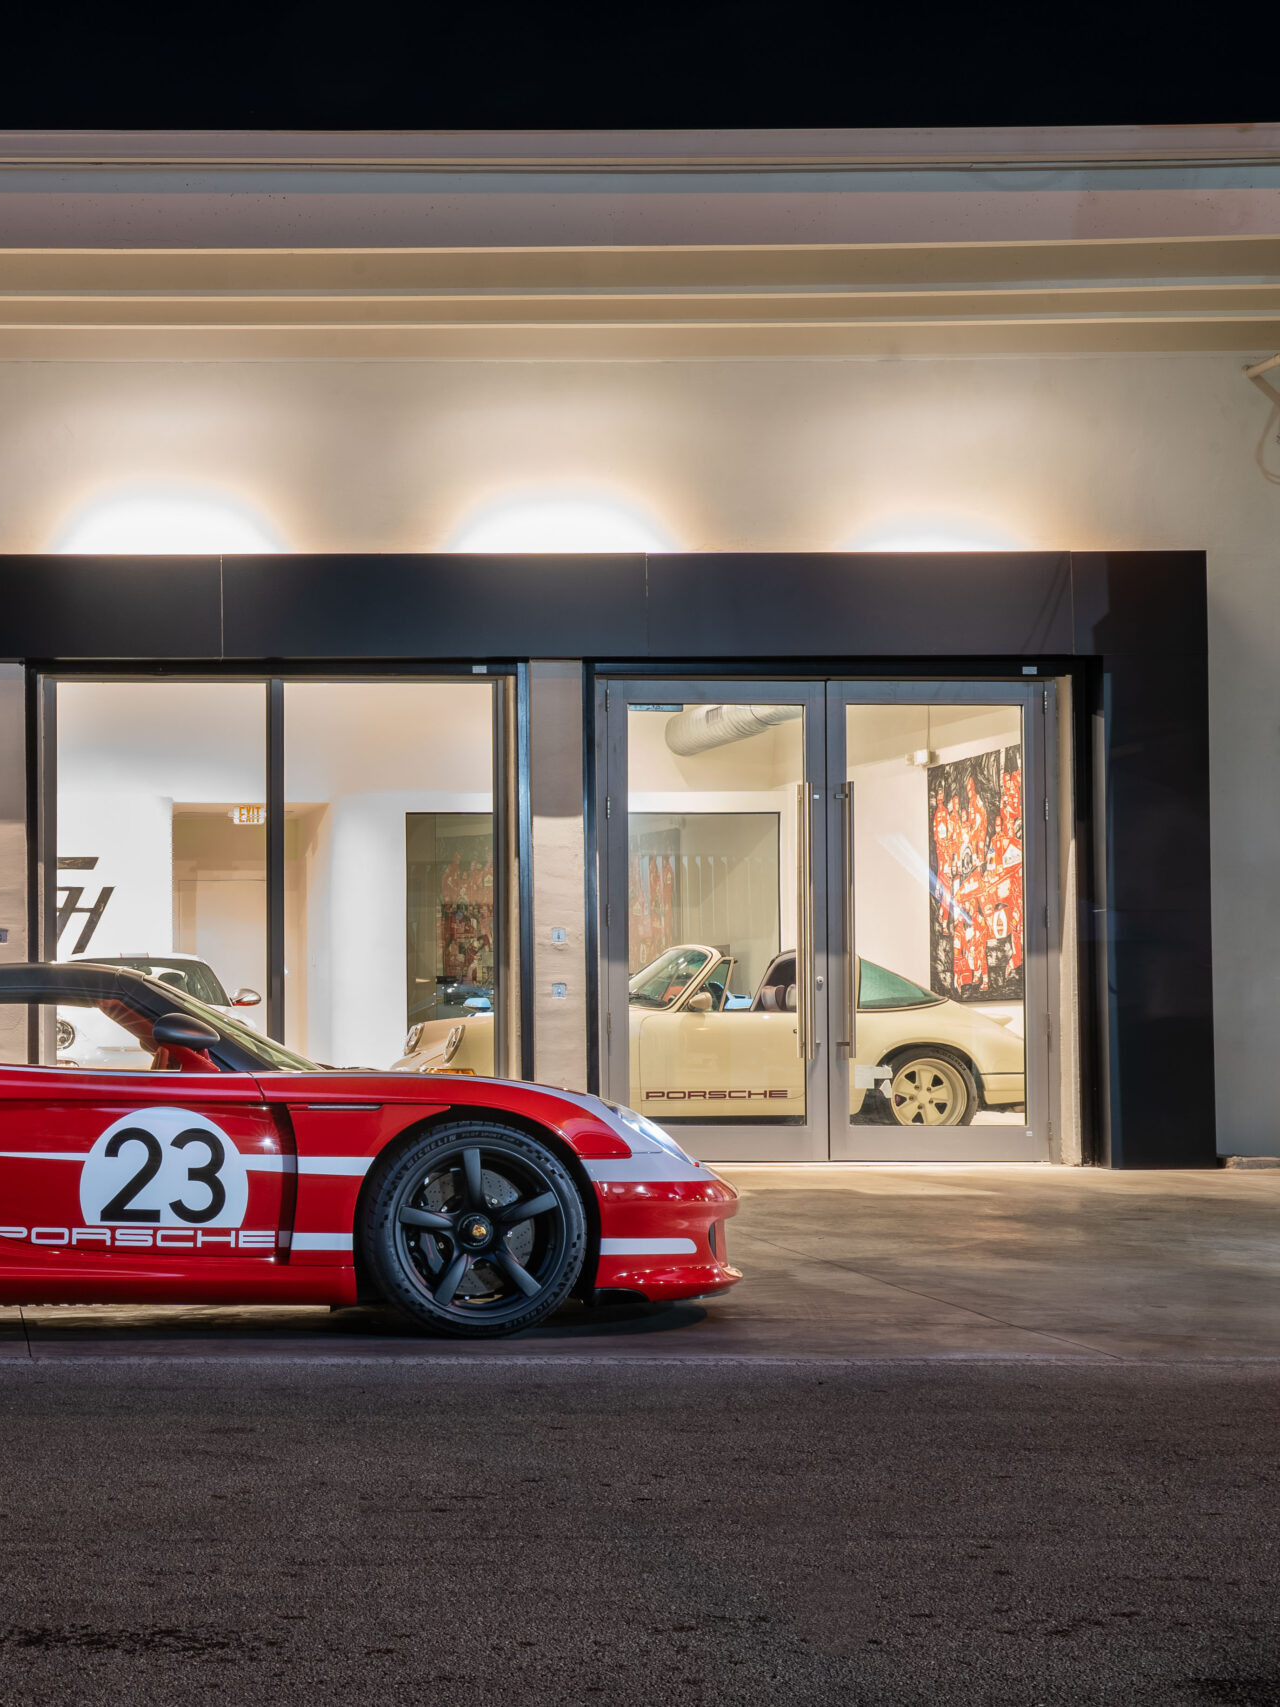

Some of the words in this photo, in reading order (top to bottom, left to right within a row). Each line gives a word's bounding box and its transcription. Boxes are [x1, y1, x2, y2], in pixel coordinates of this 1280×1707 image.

[239, 806, 261, 823] EXIT
[645, 1089, 789, 1101] PORSCHE
[406, 1134, 458, 1168] MICHELIN
[99, 1127, 226, 1224] 23
